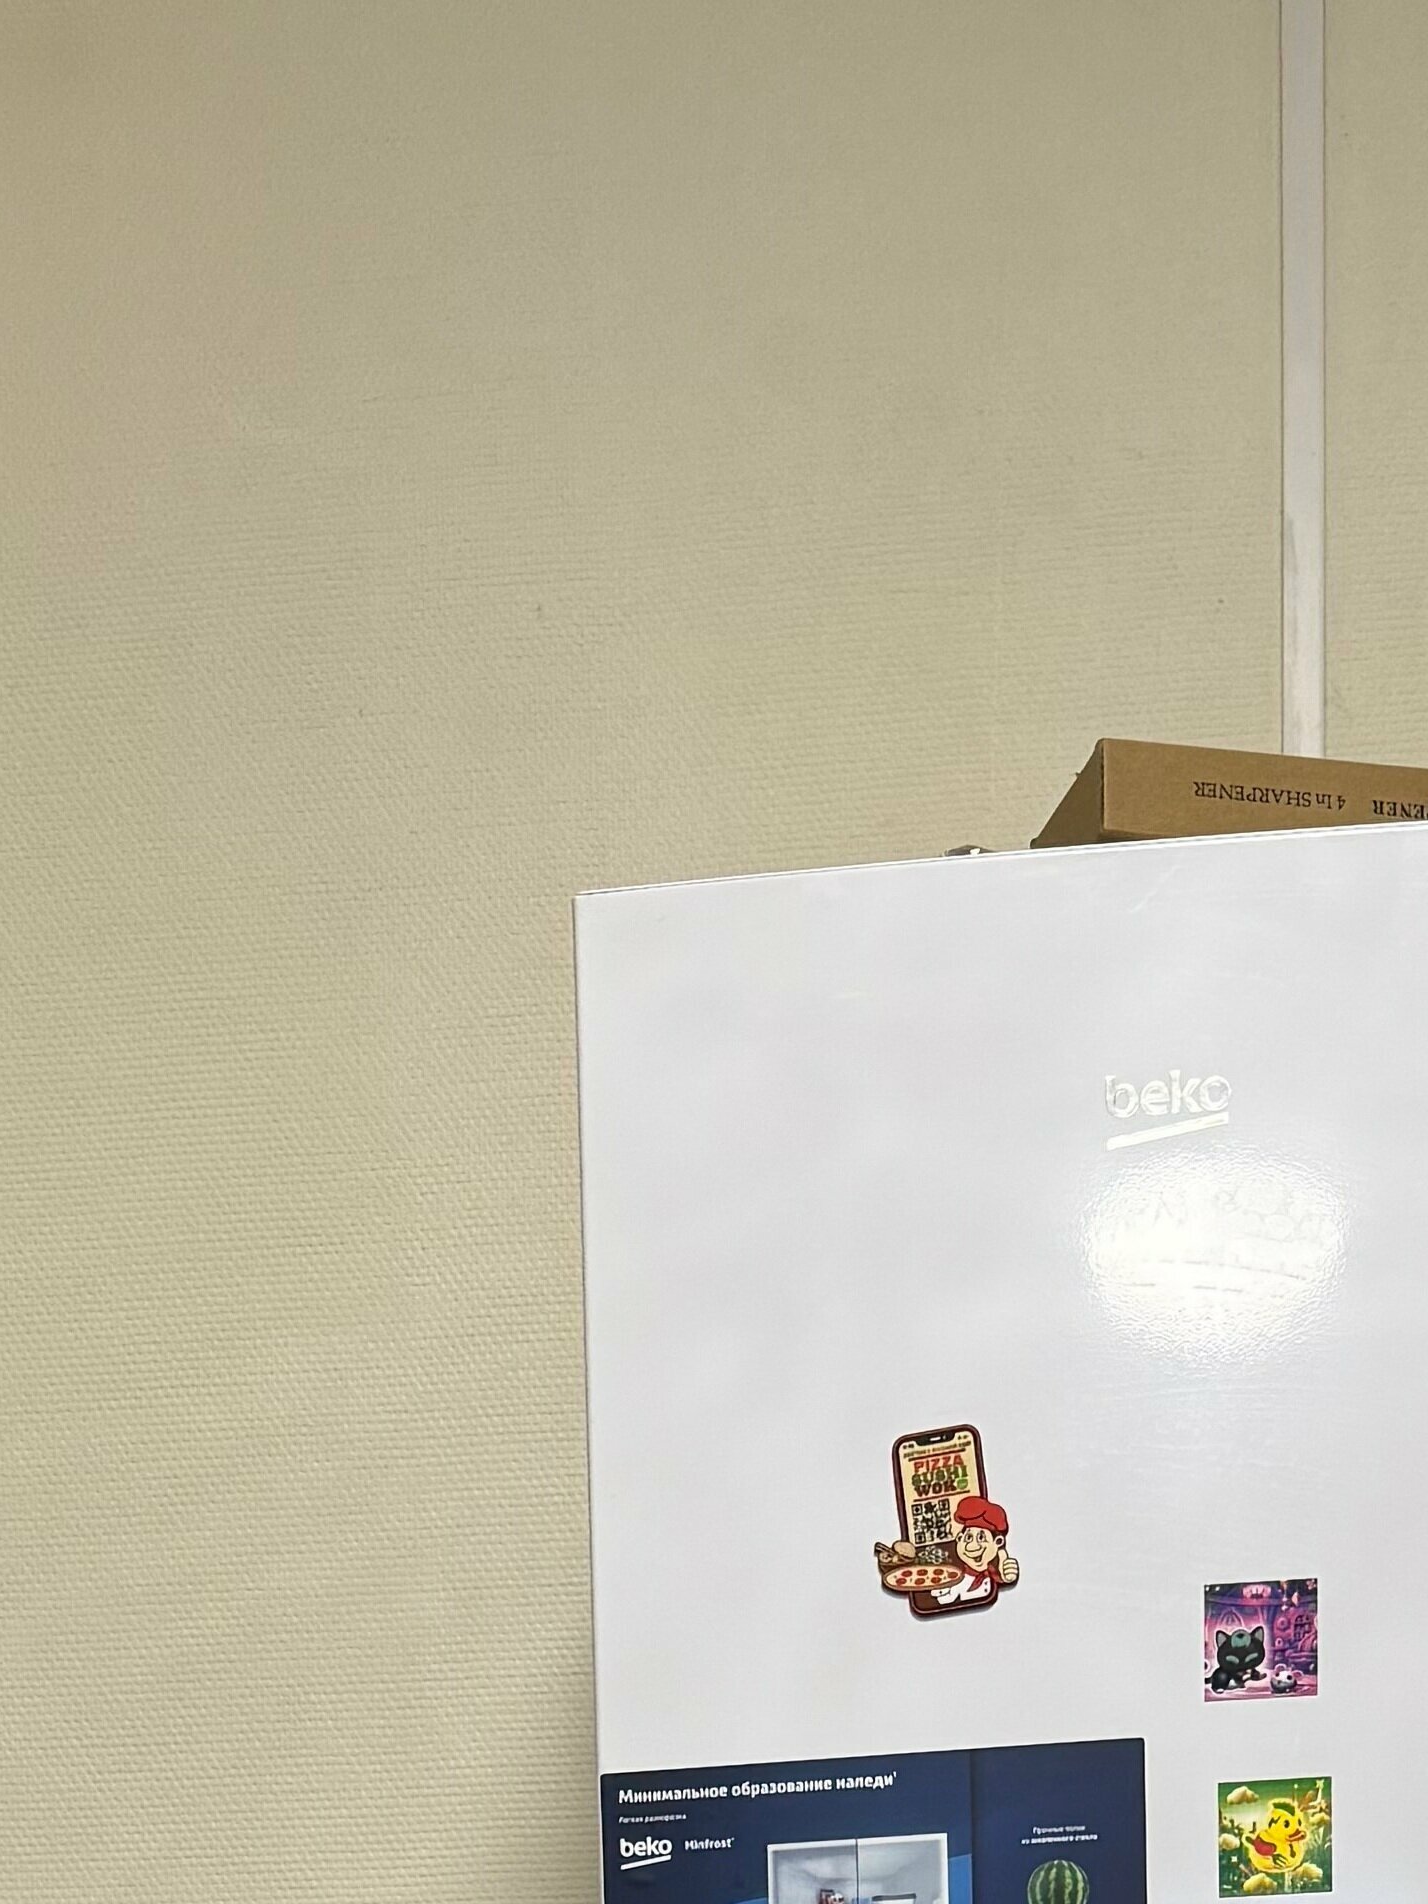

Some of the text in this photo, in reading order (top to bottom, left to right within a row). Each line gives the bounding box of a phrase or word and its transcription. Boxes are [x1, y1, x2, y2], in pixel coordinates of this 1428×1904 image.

[1193, 781, 1312, 809] SHARPENER
[1336, 796, 1347, 811] 4
[1104, 1069, 1232, 1119] beko
[913, 1453, 964, 1474] PIZZA
[913, 1478, 958, 1498] WOK
[618, 1786, 728, 1805] Минимальное
[731, 1778, 833, 1799] образование
[619, 1836, 673, 1858] beko
